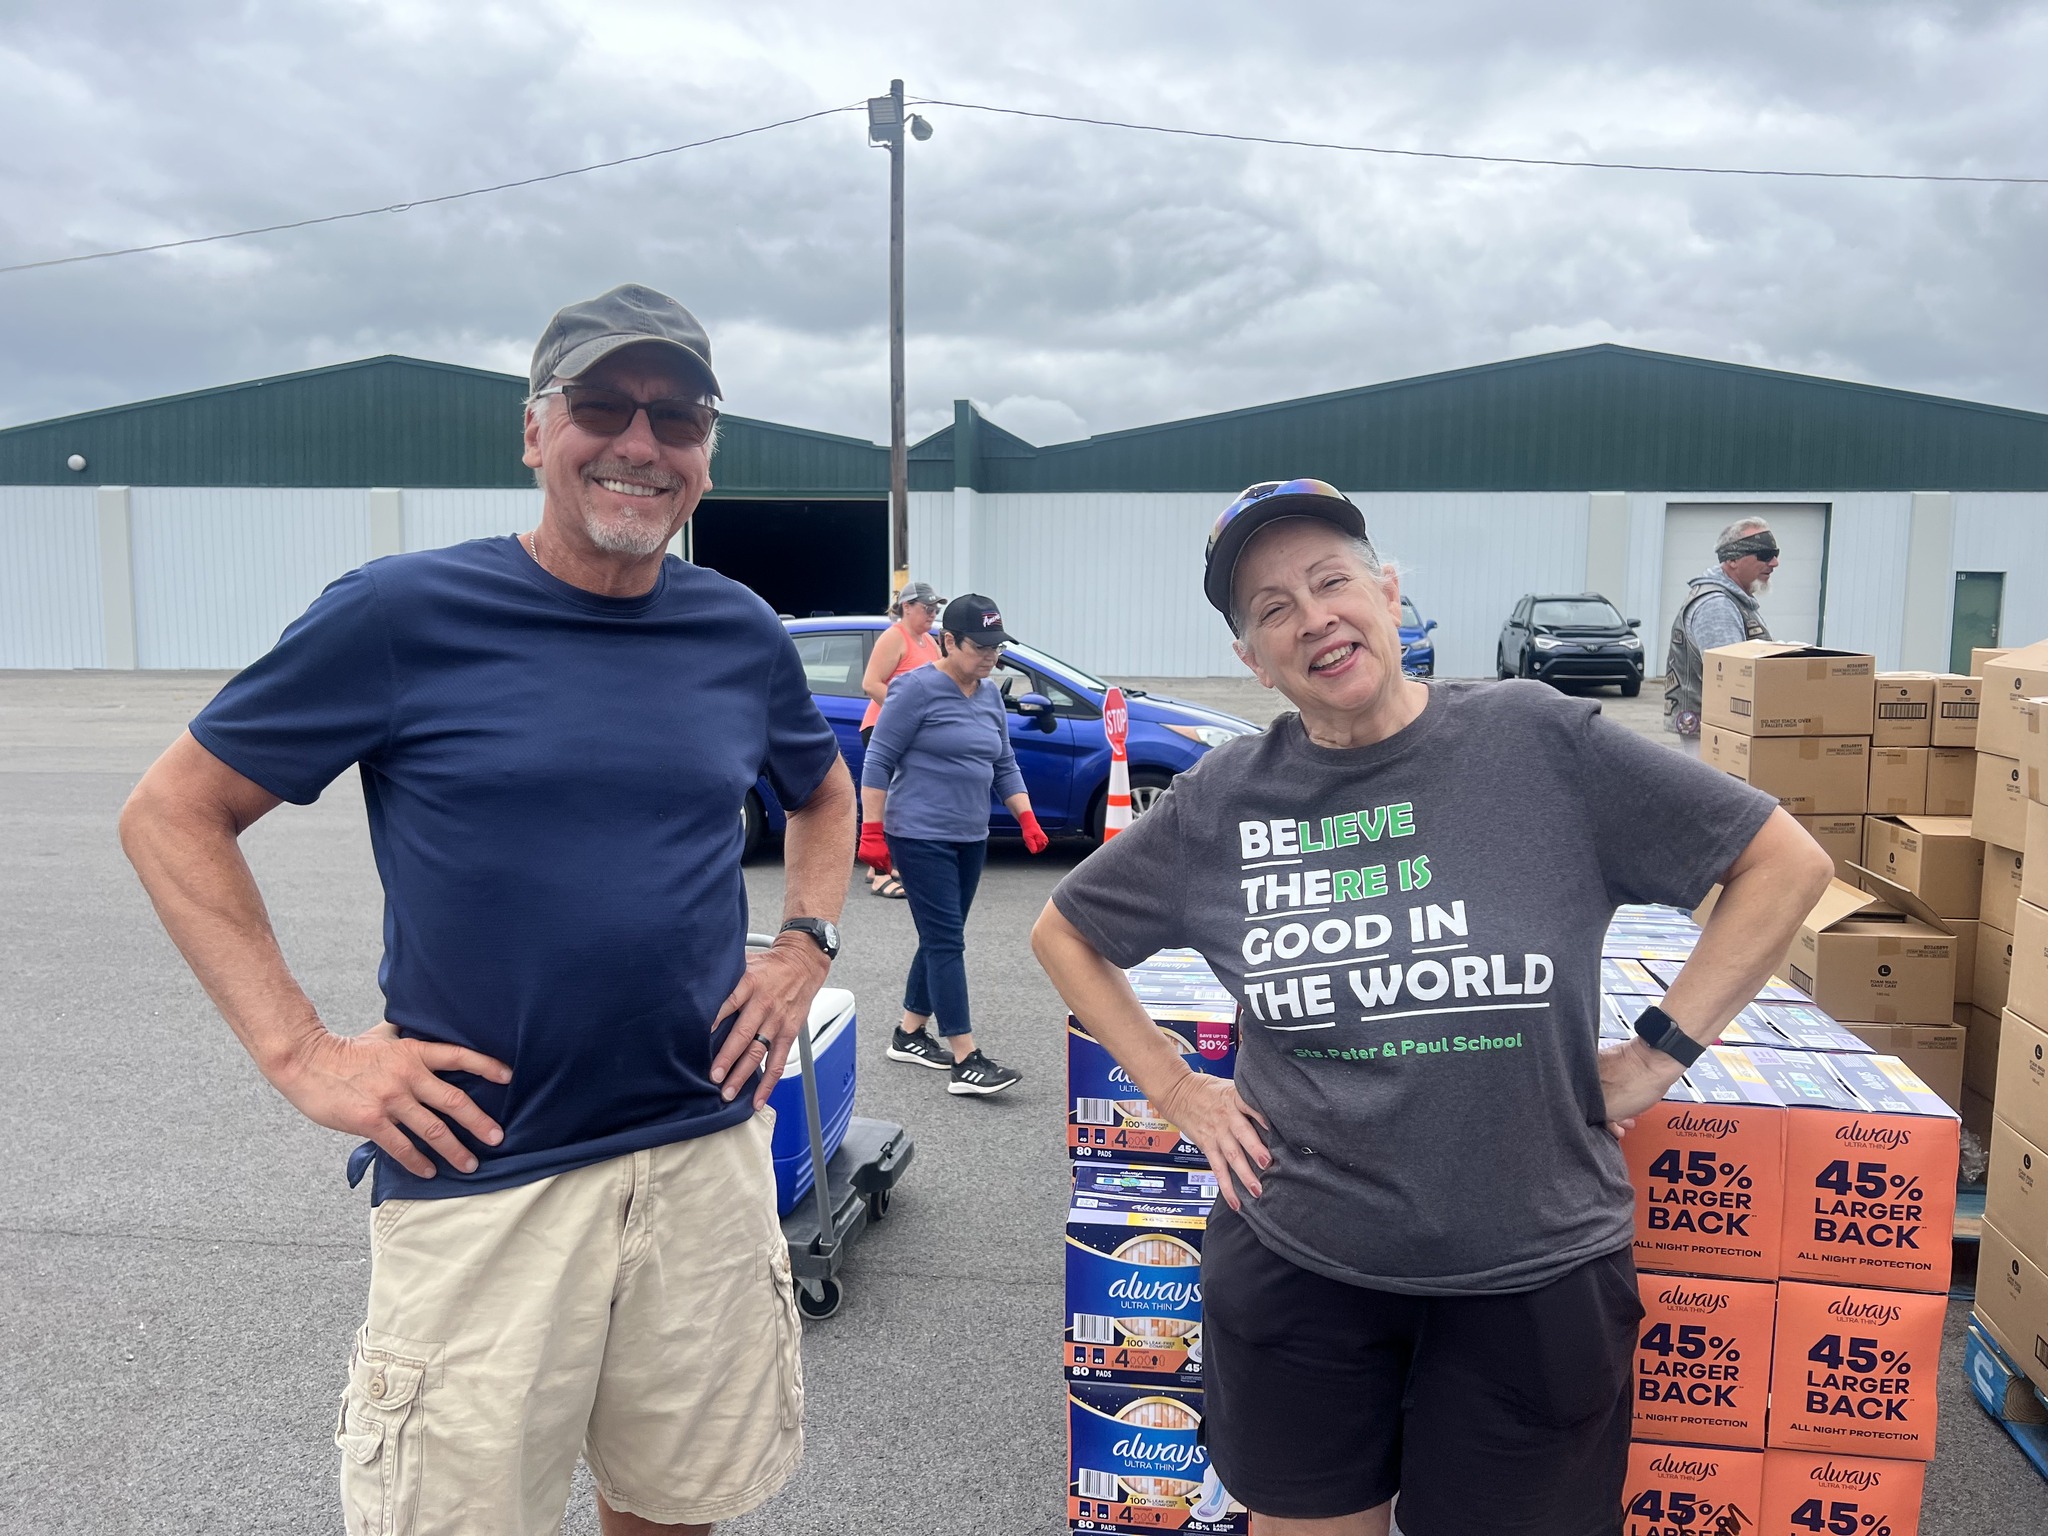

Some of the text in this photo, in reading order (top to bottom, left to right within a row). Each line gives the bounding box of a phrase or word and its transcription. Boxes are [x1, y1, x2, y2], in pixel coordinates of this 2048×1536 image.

[1106, 707, 1128, 736] STOP
[1239, 802, 1416, 860] BELIEVE
[1241, 855, 1433, 914] THERE IS
[1242, 900, 1469, 966] GOOD IN
[1244, 953, 1555, 1021] THE WORLD
[1199, 1040, 1228, 1050] 30%
[1382, 1042, 1398, 1058] &
[1401, 1037, 1450, 1056] Paul
[1452, 1032, 1524, 1052] School
[1125, 1120, 1145, 1128] 100%
[1667, 1111, 1740, 1139] always
[1836, 1120, 1911, 1150] always
[1115, 1130, 1128, 1148] 4
[1178, 1144, 1199, 1154] 45%
[1076, 1147, 1092, 1156] 80
[1649, 1149, 1753, 1189] 45%
[1815, 1160, 1924, 1201] 45%
[1131, 1204, 1184, 1213] always
[1649, 1186, 1751, 1210] LARGER
[1815, 1197, 1922, 1221] LARGER
[1633, 1240, 1762, 1257] ALL NIGHT PROTECTION
[1797, 1251, 1932, 1270] ALL NIGHT PROTECTION
[1108, 1271, 1202, 1311] always
[1659, 1285, 1730, 1314] always
[1121, 1301, 1172, 1311] ULTRA THIN
[1828, 1295, 1901, 1326] always
[1640, 1323, 1740, 1362] 45%
[1808, 1334, 1911, 1374] 45%
[1115, 1349, 1129, 1368] 4
[1185, 1364, 1202, 1373] 45
[1640, 1359, 1739, 1381] LARGER
[1072, 1367, 1112, 1378] 80 PADS
[1807, 1370, 1910, 1394] LARGER
[1646, 1413, 1678, 1423] NIGHT
[1681, 1417, 1748, 1428] PROTECTION
[1790, 1423, 1919, 1440] ALL NIGHT PROTECTION
[1112, 1433, 1207, 1471] always
[1124, 1460, 1175, 1471] ULTRA THIN
[1650, 1453, 1719, 1481] always
[1810, 1462, 1881, 1491] always
[1130, 1497, 1151, 1505] 100%
[1632, 1490, 1729, 1527] 45%
[1077, 1520, 1116, 1532] 80 PADS
[1119, 1506, 1133, 1523] 4
[1188, 1522, 1210, 1531] 45%
[1791, 1499, 1891, 1536] 45%
